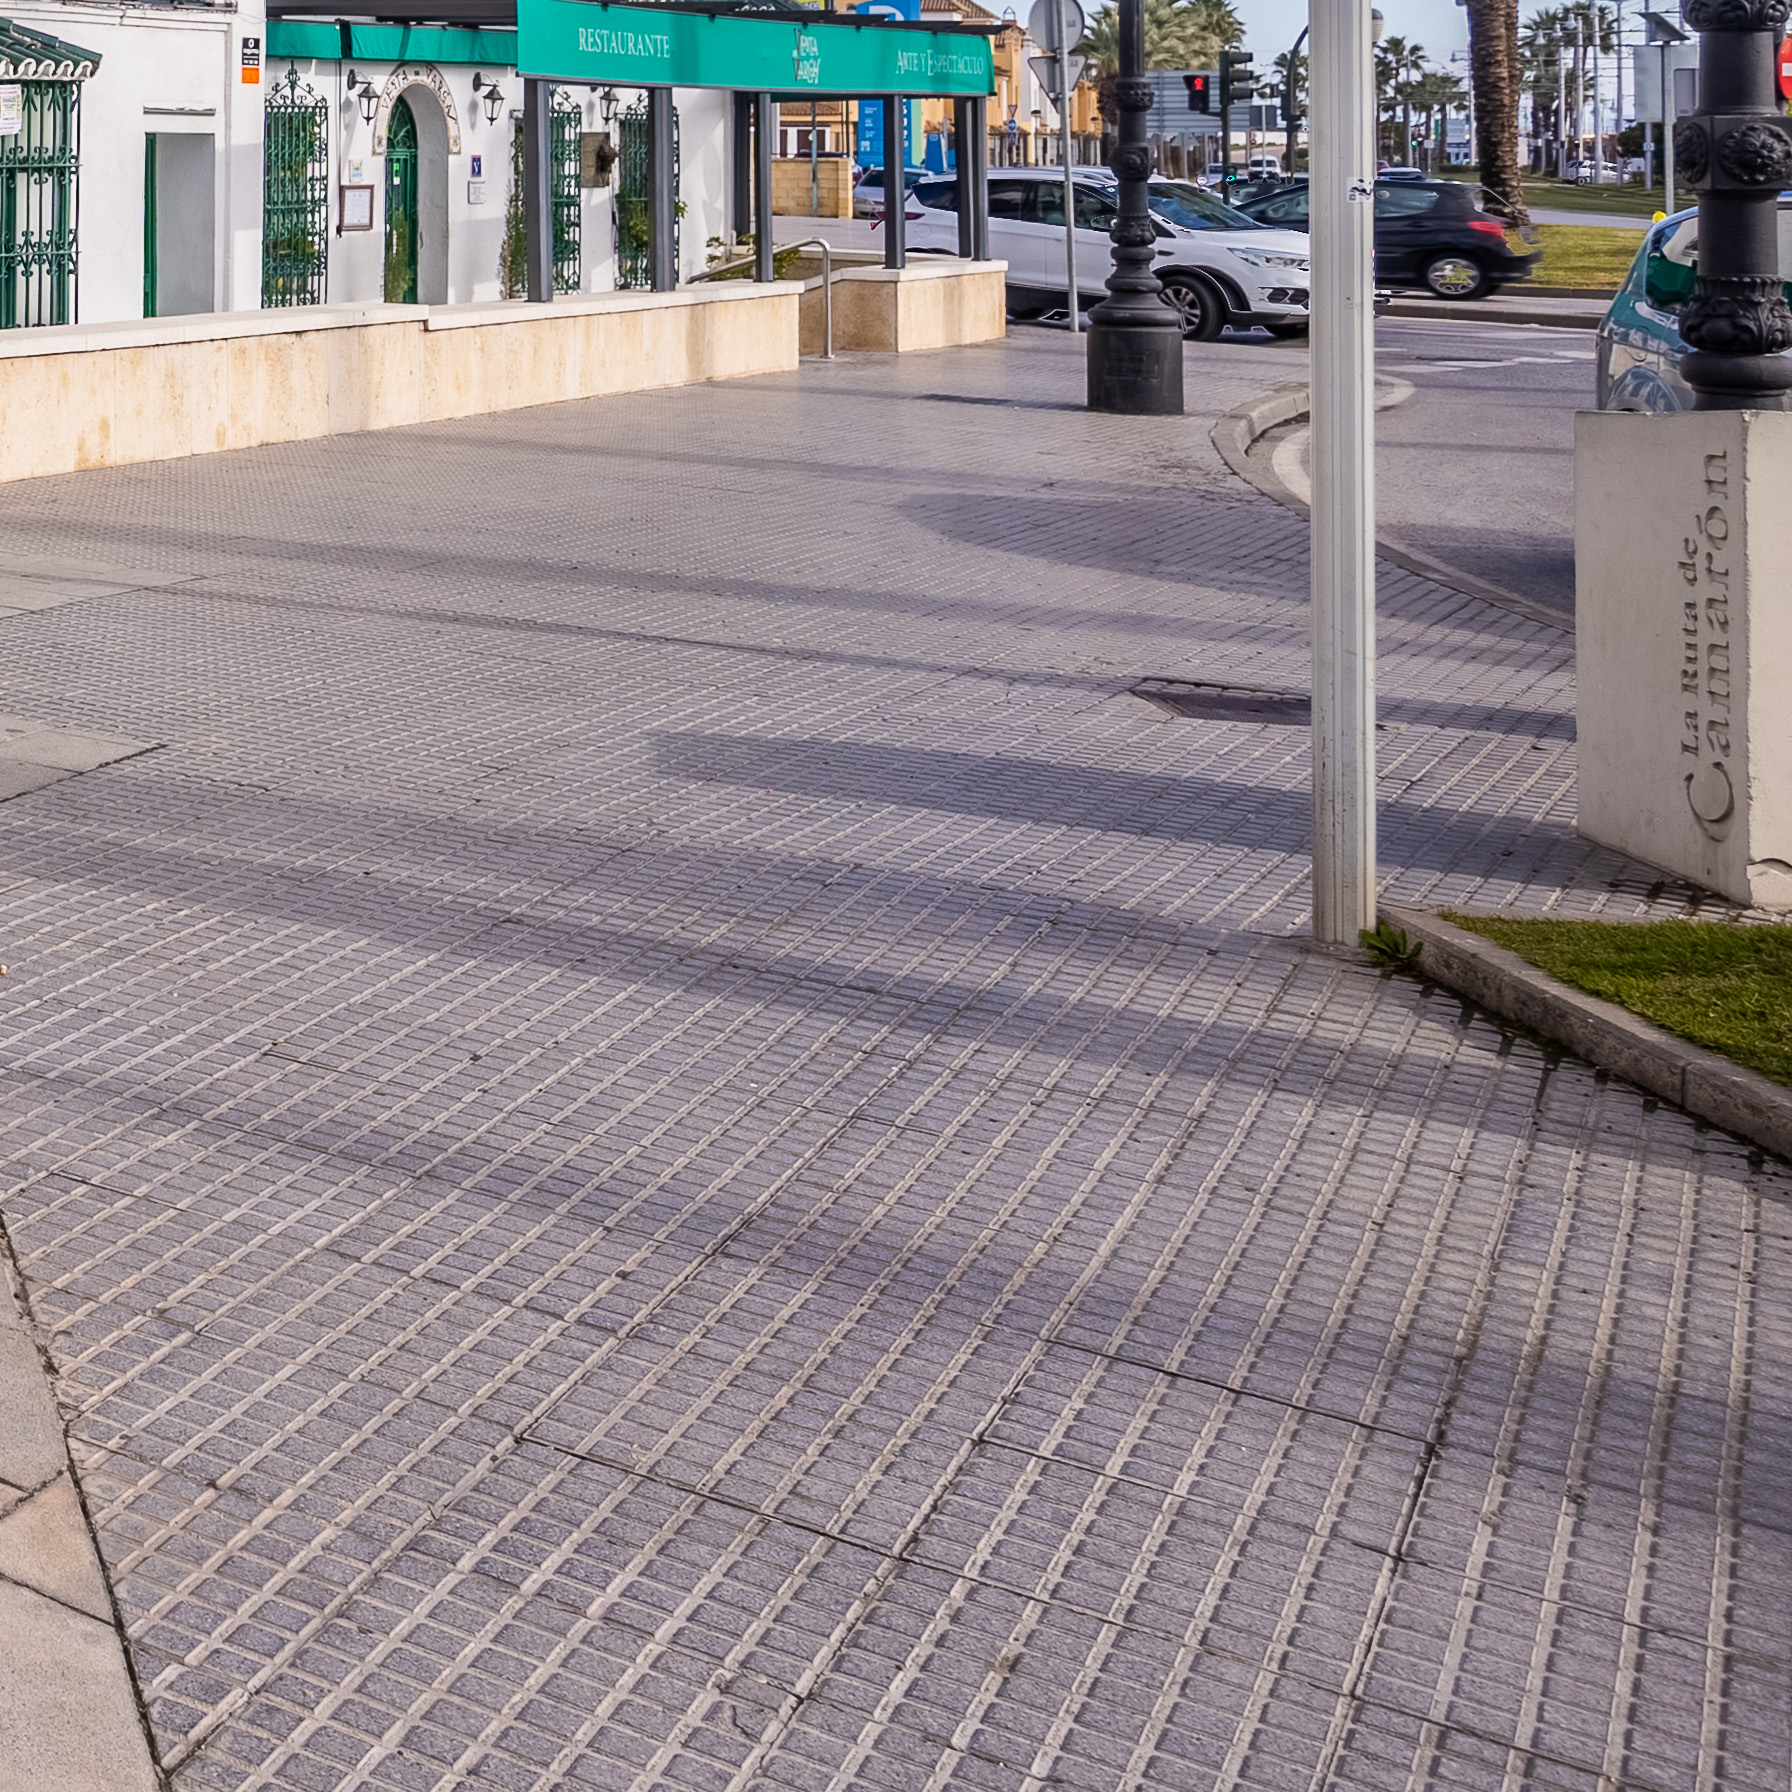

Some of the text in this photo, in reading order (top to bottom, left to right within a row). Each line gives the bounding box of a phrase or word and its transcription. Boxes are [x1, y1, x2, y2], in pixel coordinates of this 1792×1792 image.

[578, 27, 671, 58] RESTAURANTE
[920, 53, 926, 72] Y
[1676, 536, 1699, 758] La Ruta de
[1683, 449, 1736, 843] Camarón
